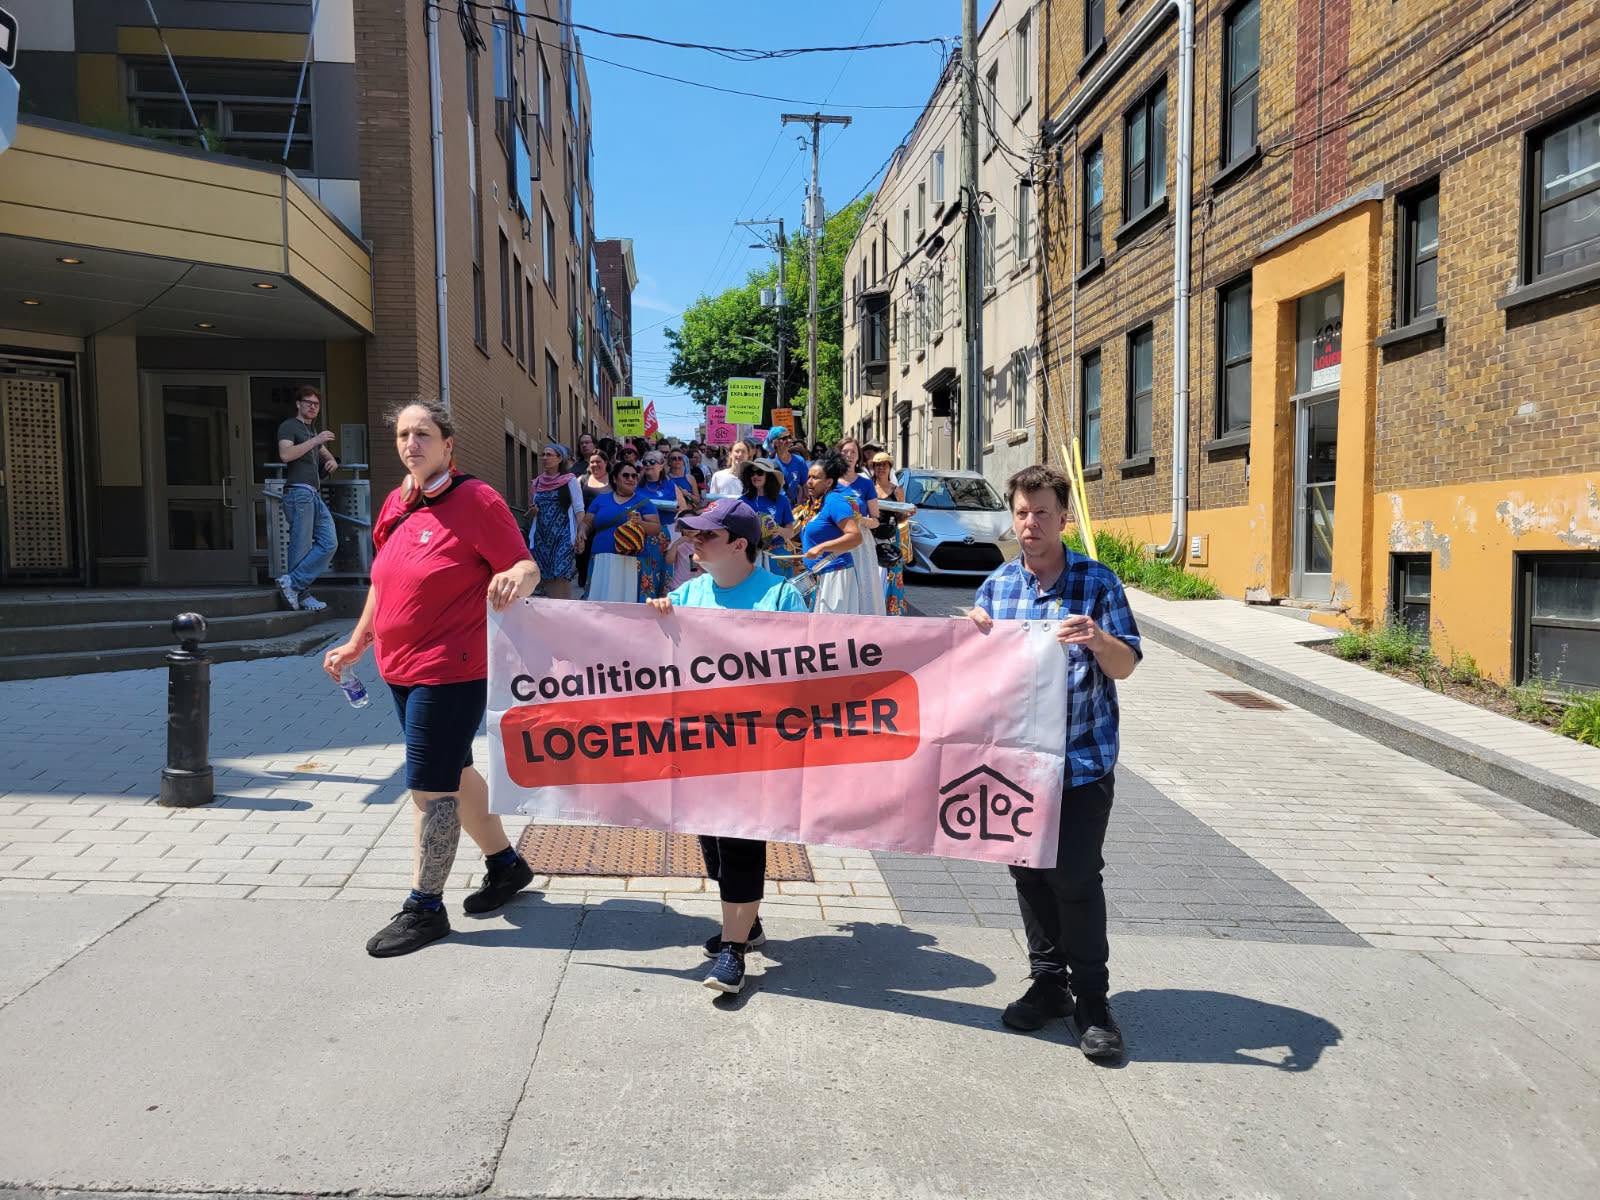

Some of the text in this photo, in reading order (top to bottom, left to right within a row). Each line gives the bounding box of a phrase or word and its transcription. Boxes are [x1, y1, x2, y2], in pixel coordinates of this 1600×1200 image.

[510, 638, 883, 702] Coalition CONTRE le
[521, 698, 899, 764] LOGEMENT CHER
